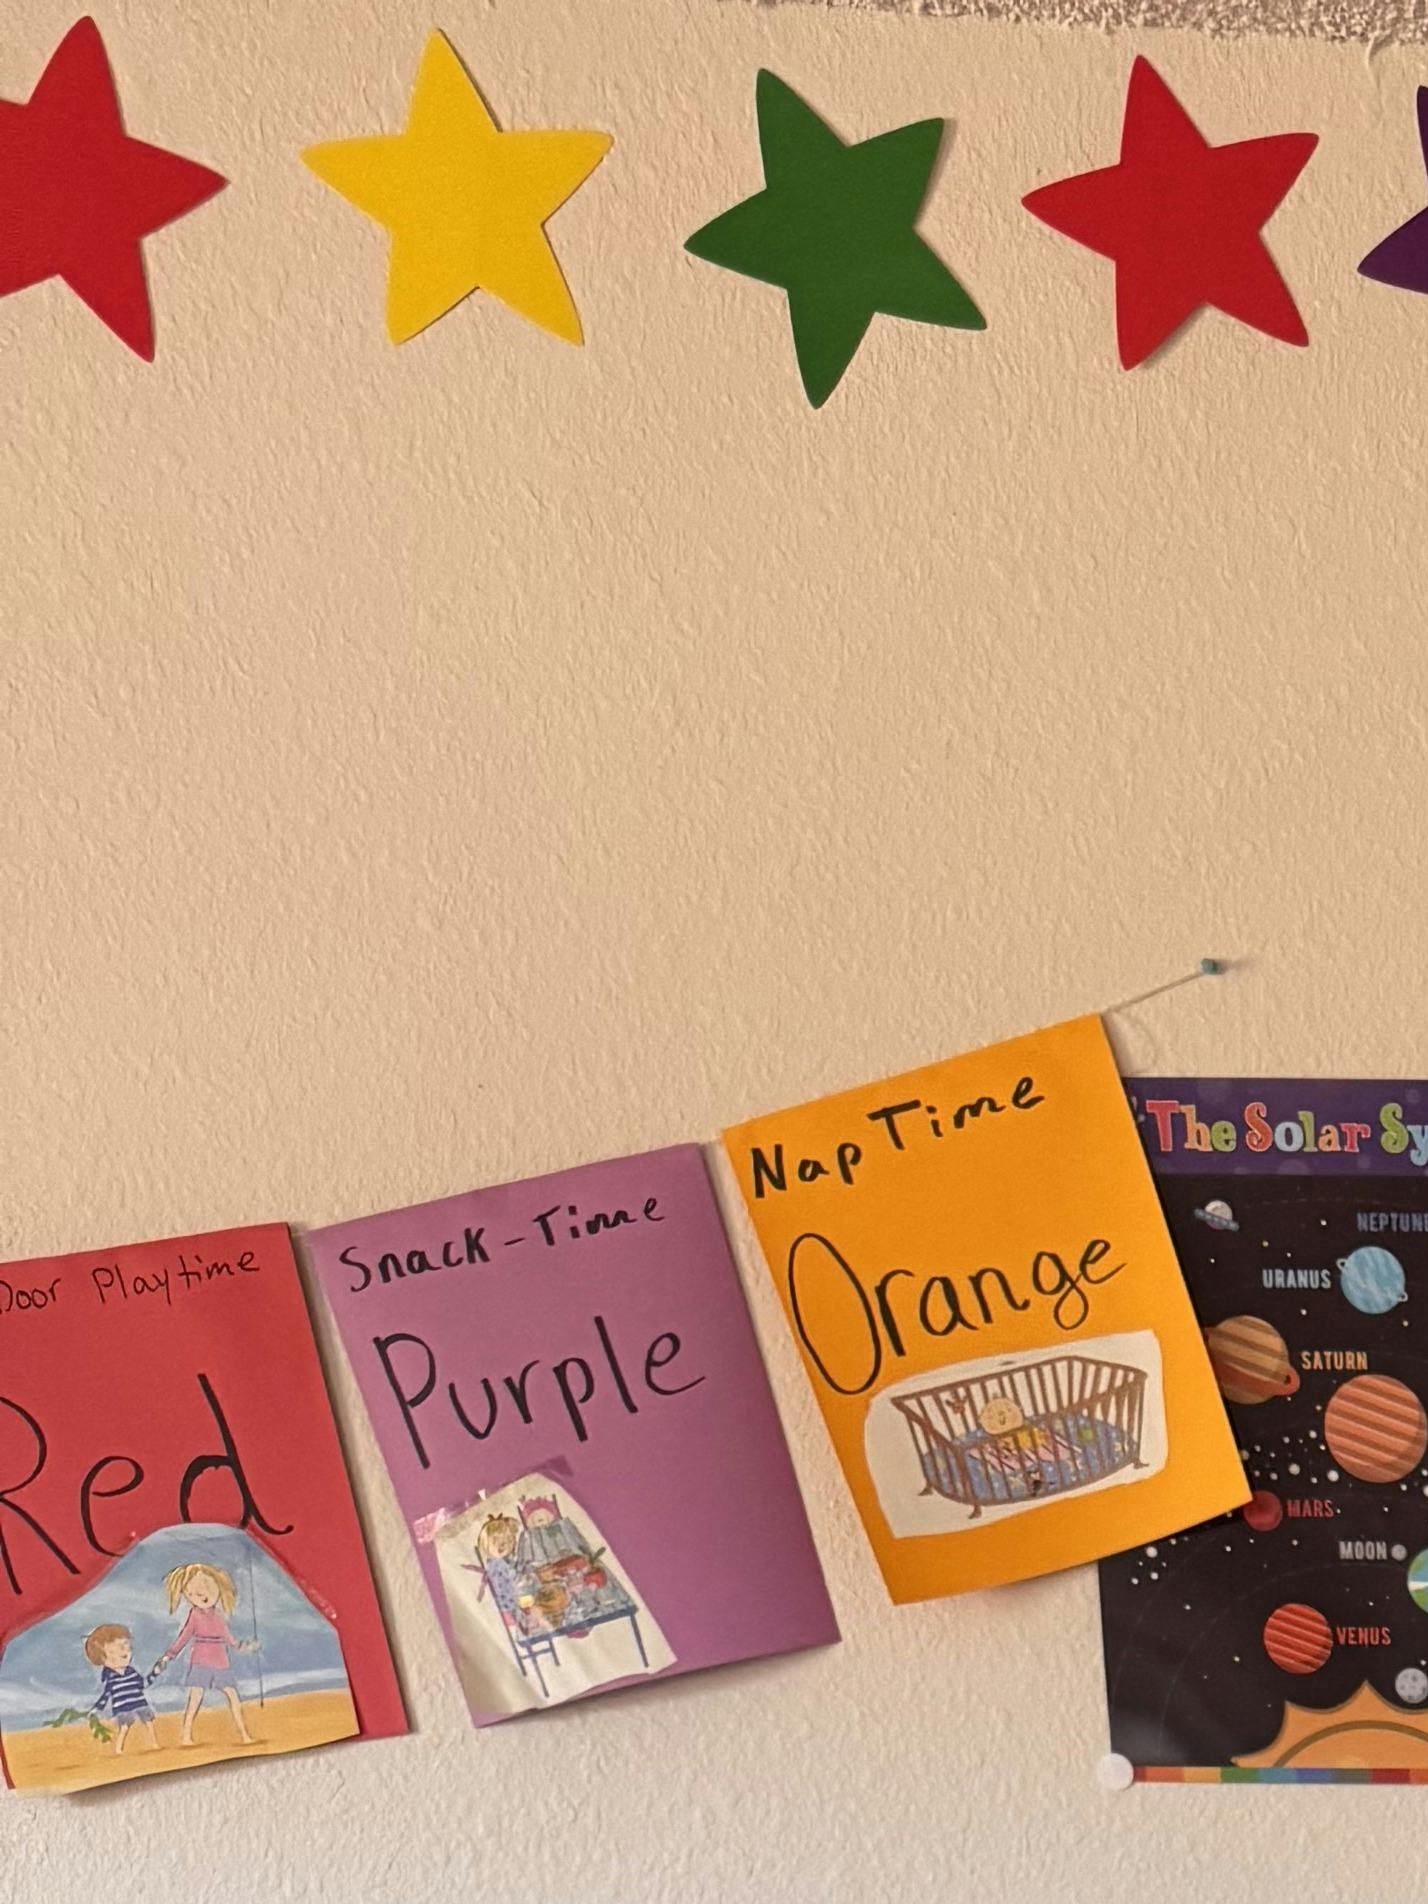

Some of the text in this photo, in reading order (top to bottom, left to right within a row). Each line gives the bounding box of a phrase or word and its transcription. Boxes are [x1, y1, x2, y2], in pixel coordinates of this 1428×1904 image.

[752, 1070, 1044, 1200] Nap Time
[1146, 1099, 1237, 1152] The
[1245, 1103, 1372, 1154] Solar
[1263, 1269, 1331, 1289] URANUS
[785, 1229, 1127, 1395] Orange
[1301, 1351, 1368, 1370] SATURN
[371, 1314, 708, 1470] Purple
[0, 1372, 294, 1595] Red
[1288, 1500, 1333, 1518] MARS
[1339, 1542, 1388, 1561] MOON
[1337, 1626, 1391, 1645] VENUS
